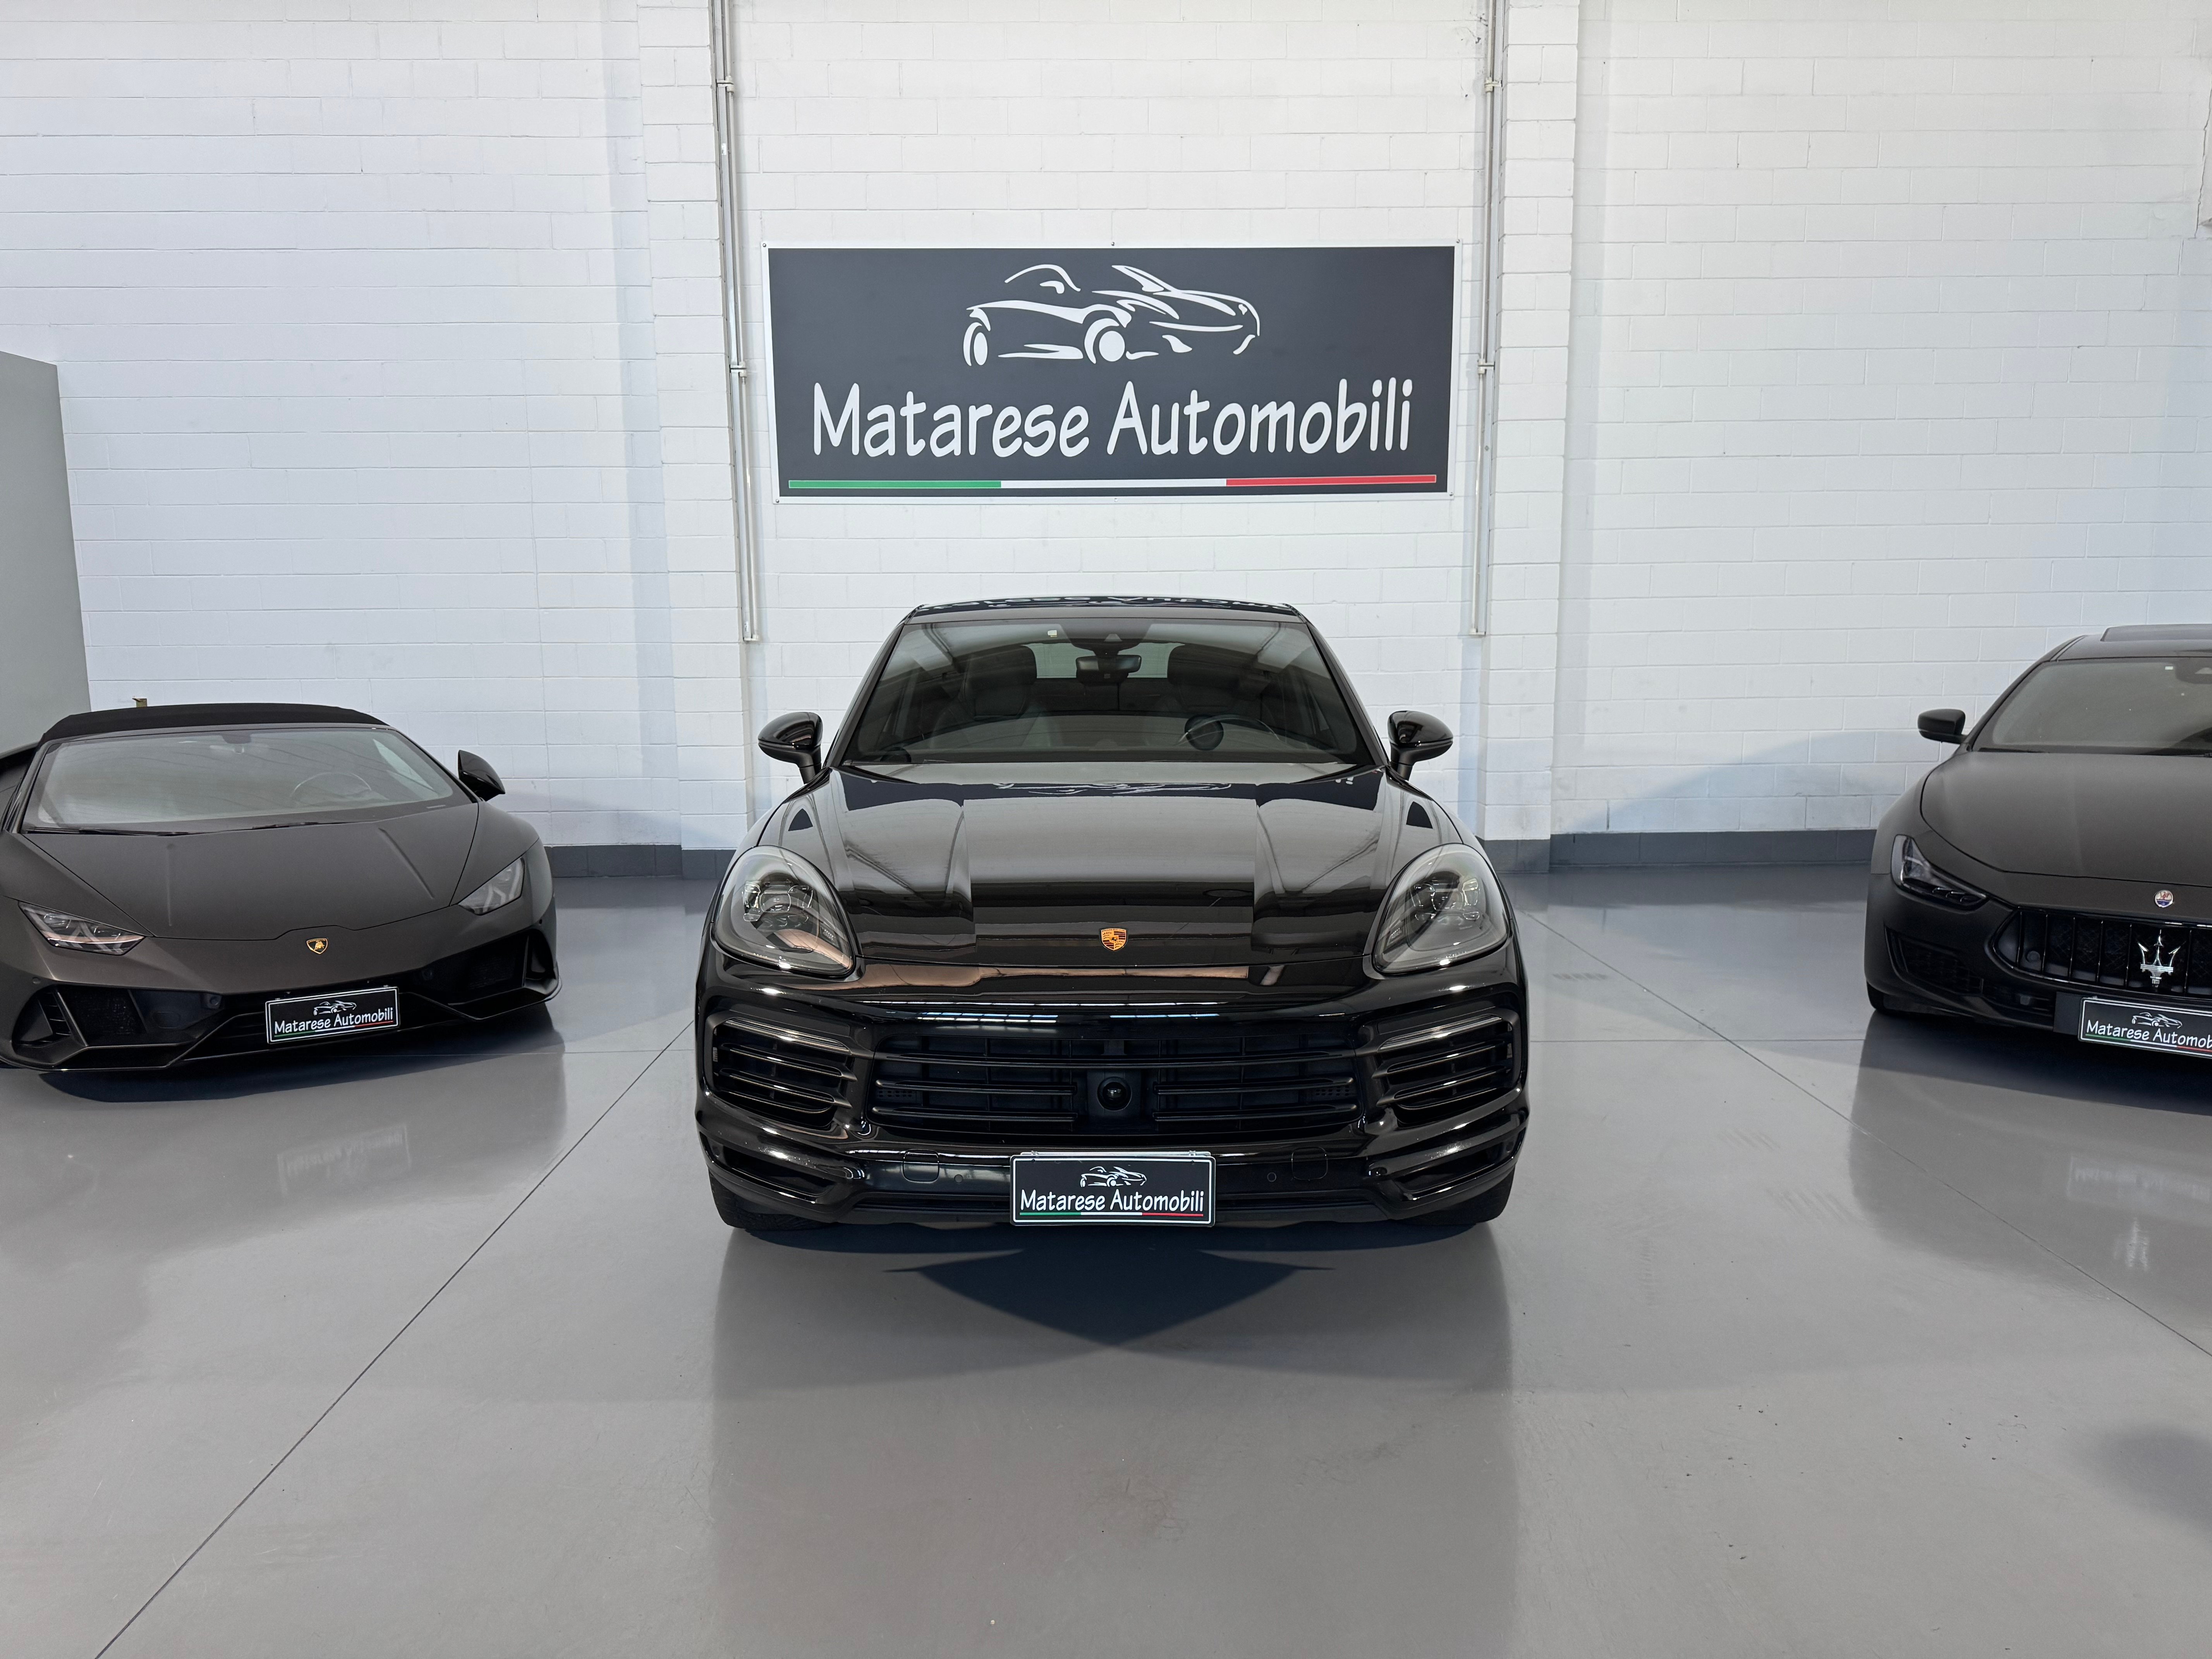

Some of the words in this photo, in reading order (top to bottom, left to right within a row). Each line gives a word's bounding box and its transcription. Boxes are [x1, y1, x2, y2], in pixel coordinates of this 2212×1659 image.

[814, 382, 1089, 457] Matarese
[1107, 377, 1413, 455] Automobili
[275, 1018, 331, 1034] Matarese
[333, 1007, 393, 1027] Automobili
[2087, 1020, 2150, 1041] Matarese
[2152, 1028, 2212, 1049] Automob
[1020, 1189, 1105, 1211] Matarese
[1110, 1189, 1204, 1212] Automobili
